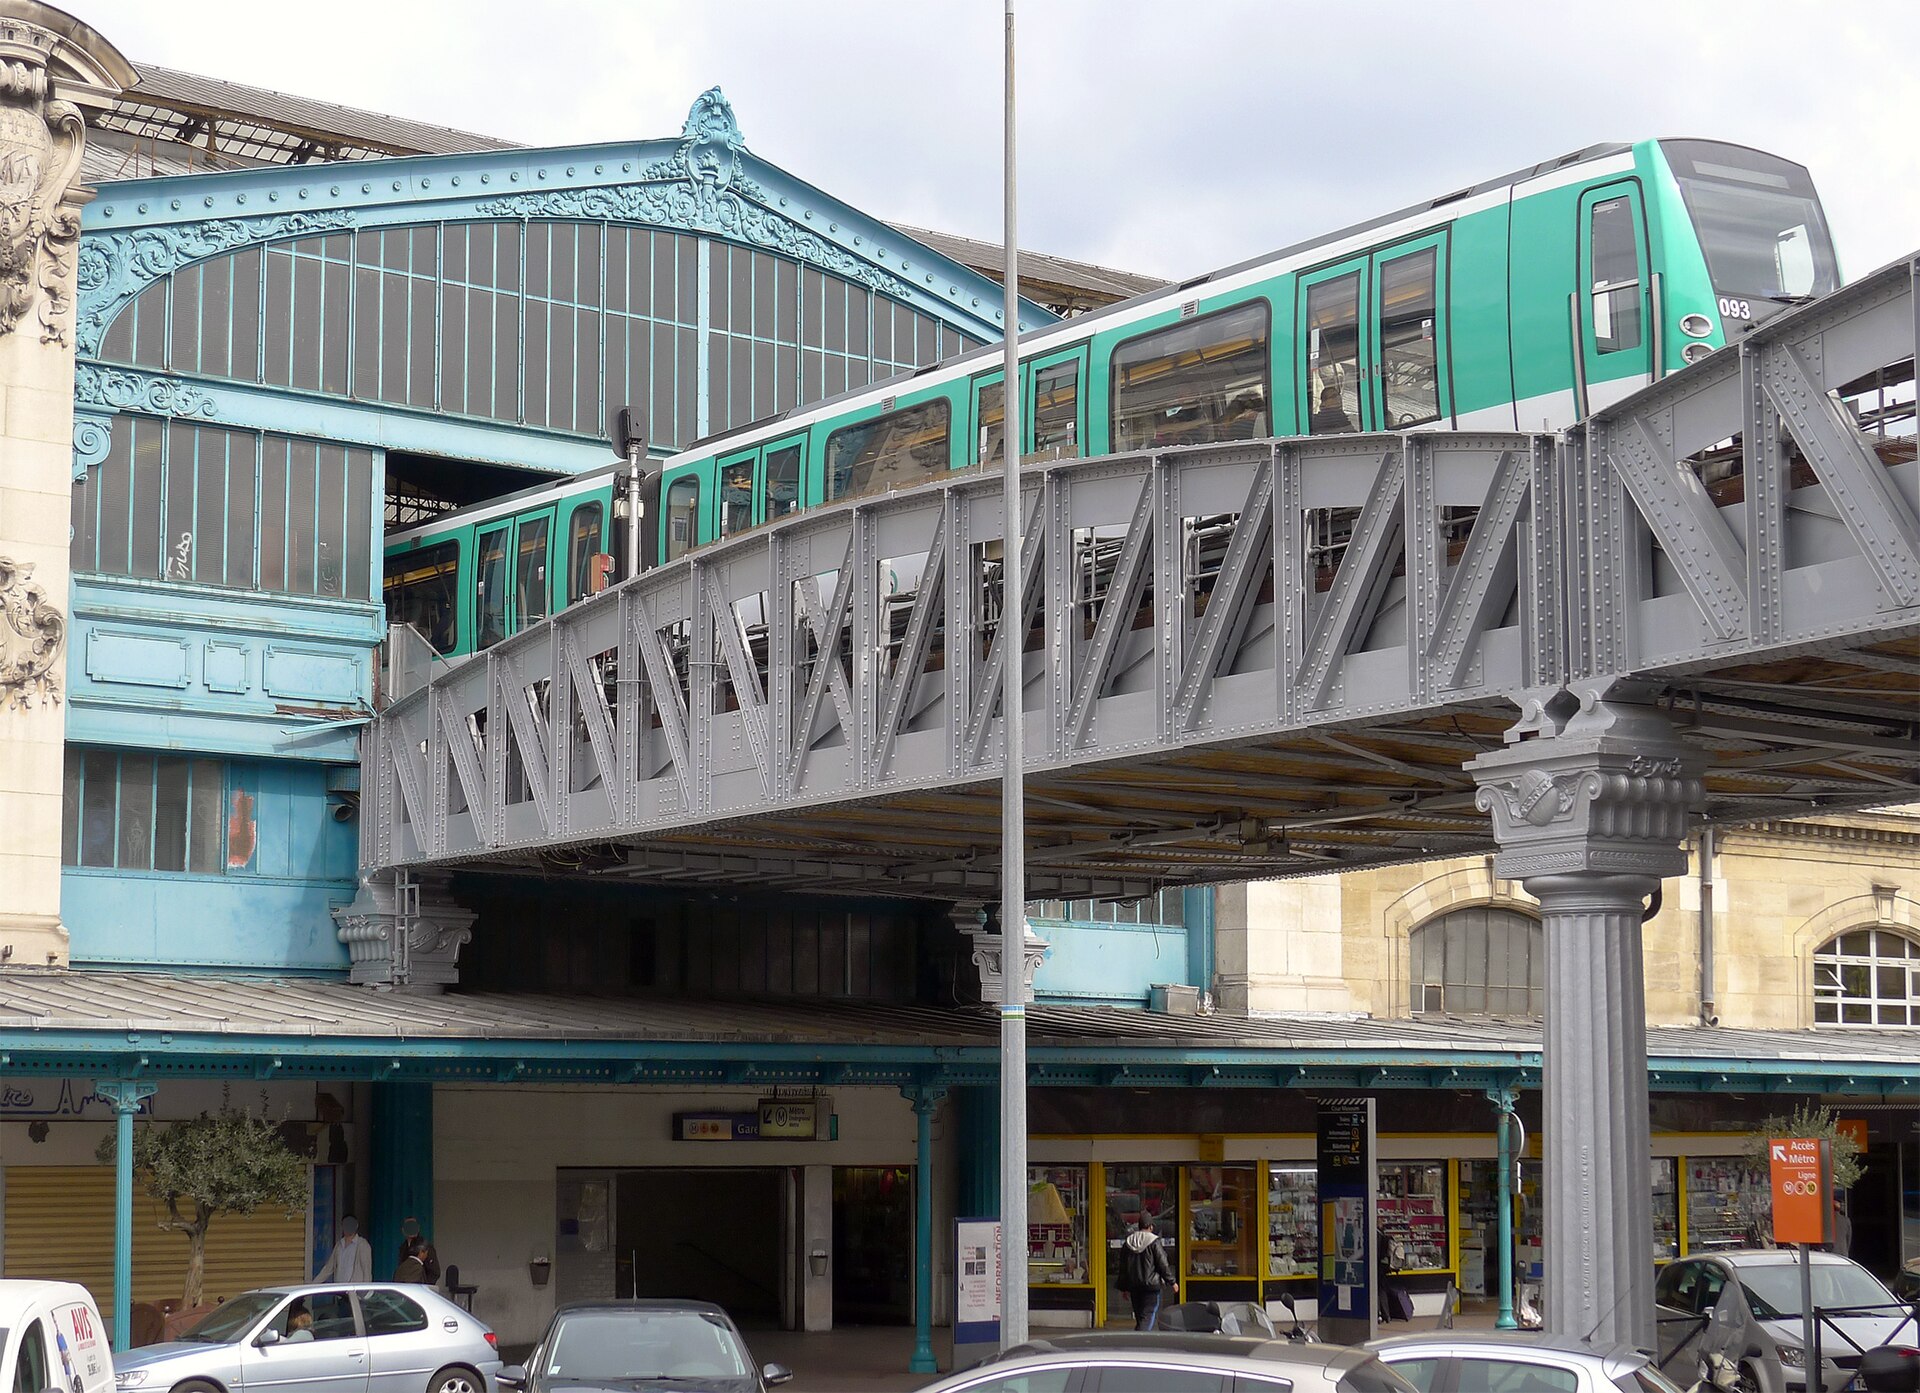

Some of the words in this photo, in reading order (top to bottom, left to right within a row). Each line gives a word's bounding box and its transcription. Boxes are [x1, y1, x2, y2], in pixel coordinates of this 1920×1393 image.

[1719, 298, 1751, 320] 093
[737, 1123, 759, 1135] Gare
[1791, 1140, 1816, 1151] Accès
[1789, 1153, 1816, 1164] Métro
[1797, 1171, 1817, 1180] Ligne
[71, 1306, 93, 1342] AVIS
